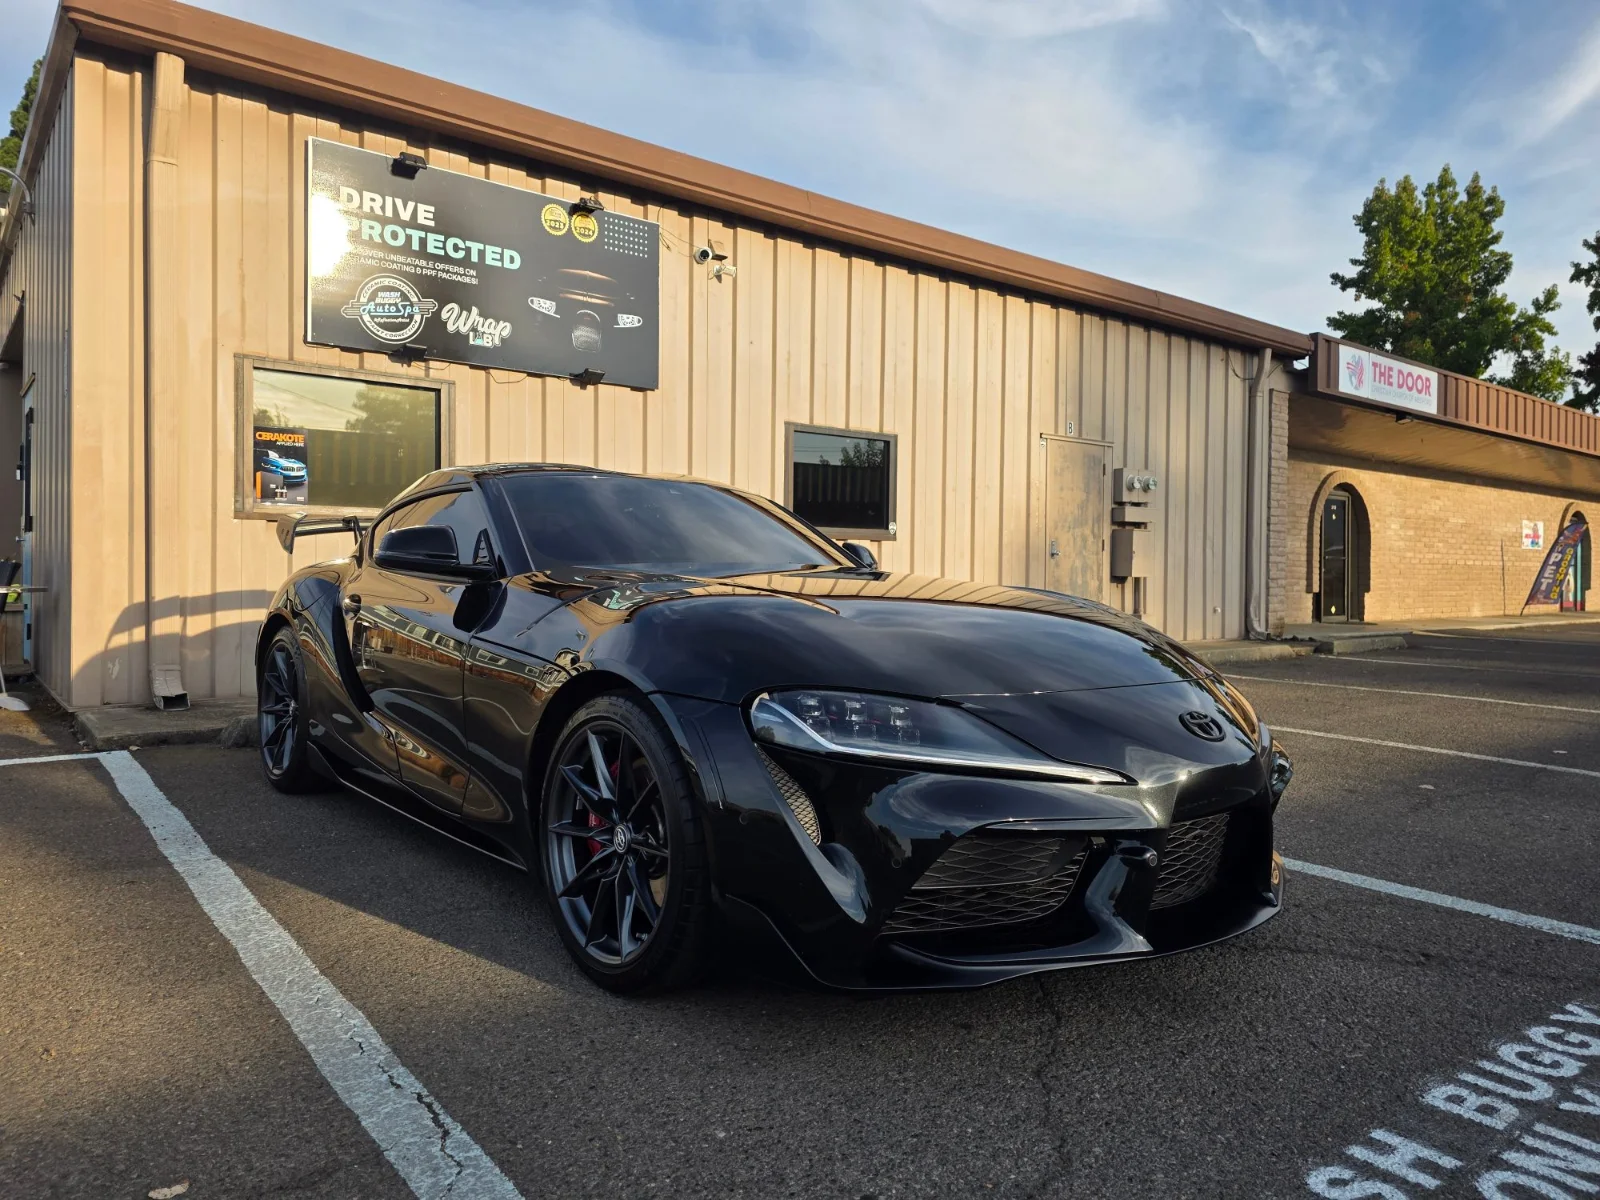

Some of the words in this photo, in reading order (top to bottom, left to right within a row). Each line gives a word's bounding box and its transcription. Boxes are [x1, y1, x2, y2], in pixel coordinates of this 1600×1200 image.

[339, 186, 435, 227] DRIVE
[346, 216, 522, 271] PROTECTED
[576, 227, 593, 236] 2024
[381, 261, 415, 273] COATING
[422, 267, 437, 277] PPF
[384, 253, 435, 269] UNBEATABLE
[434, 262, 464, 275] OFFERS
[465, 268, 477, 277] ON
[362, 279, 386, 299] CERAMIC
[387, 280, 416, 299] COATING
[366, 319, 384, 335] PAINT
[384, 319, 419, 339] CORRECTION
[440, 302, 513, 347] Wrap
[1372, 362, 1393, 387] THE
[1397, 369, 1431, 397] DOOR
[255, 431, 305, 443] CERAKOTE
[1540, 553, 1562, 591] PET
[1550, 548, 1573, 599] GROOMING
